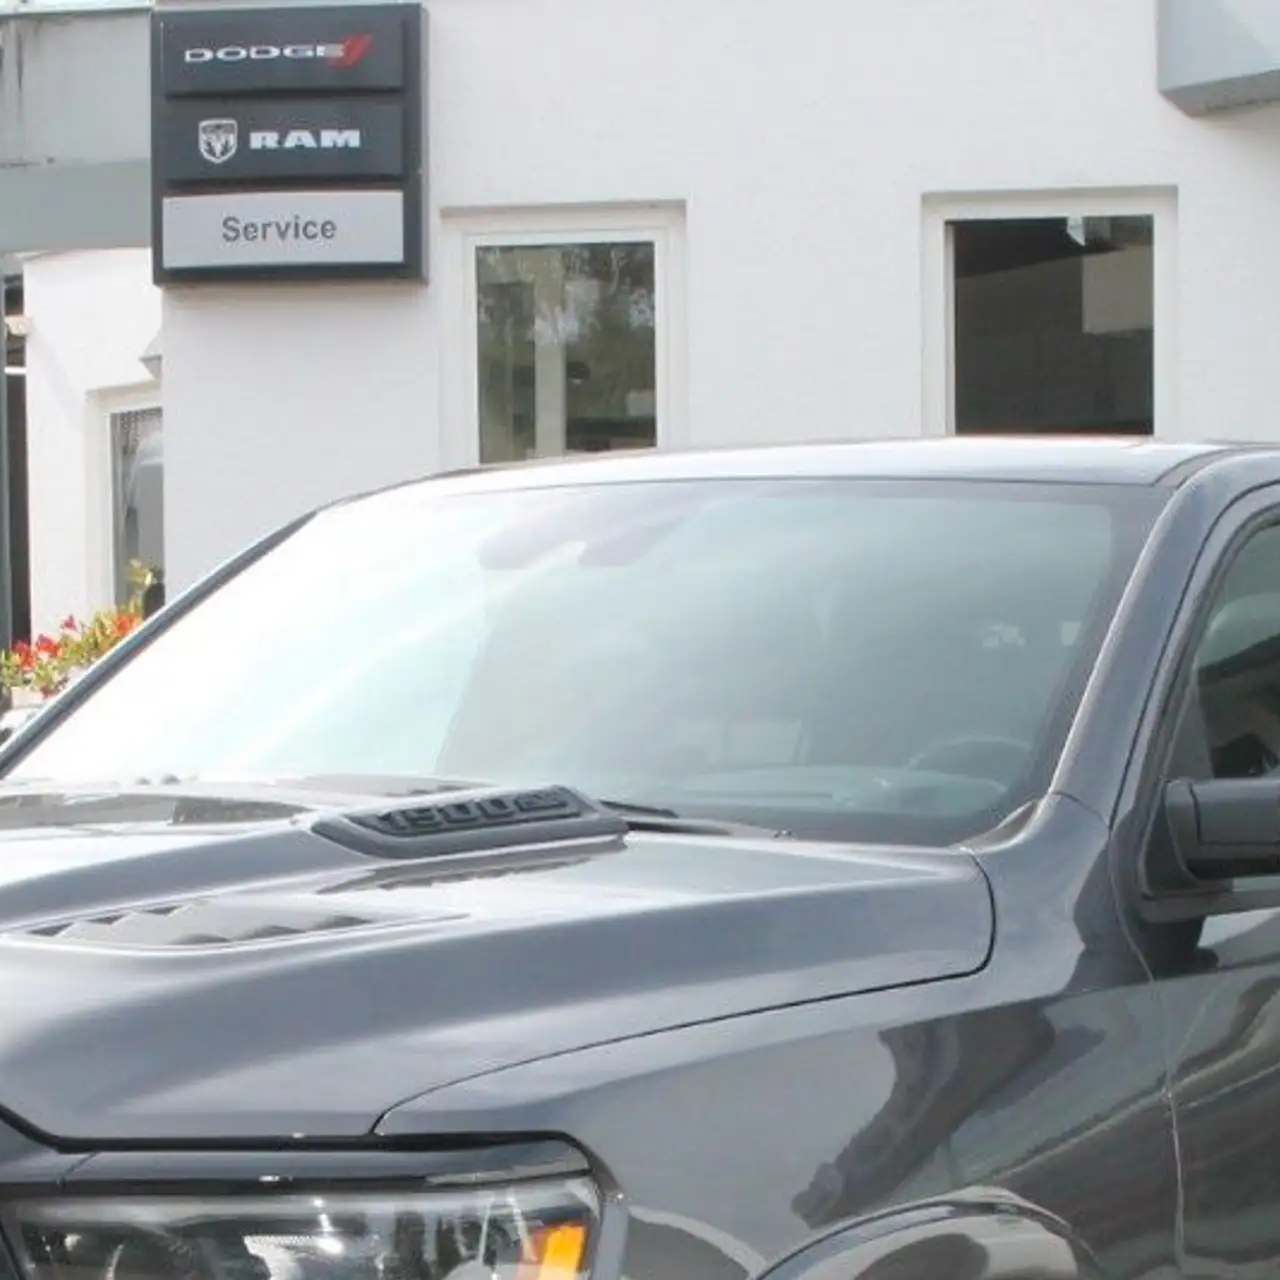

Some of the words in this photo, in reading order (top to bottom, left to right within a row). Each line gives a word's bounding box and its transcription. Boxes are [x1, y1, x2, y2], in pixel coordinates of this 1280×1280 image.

[184, 43, 345, 62] DODGE
[249, 129, 361, 149] RAM
[222, 214, 337, 243] Service
